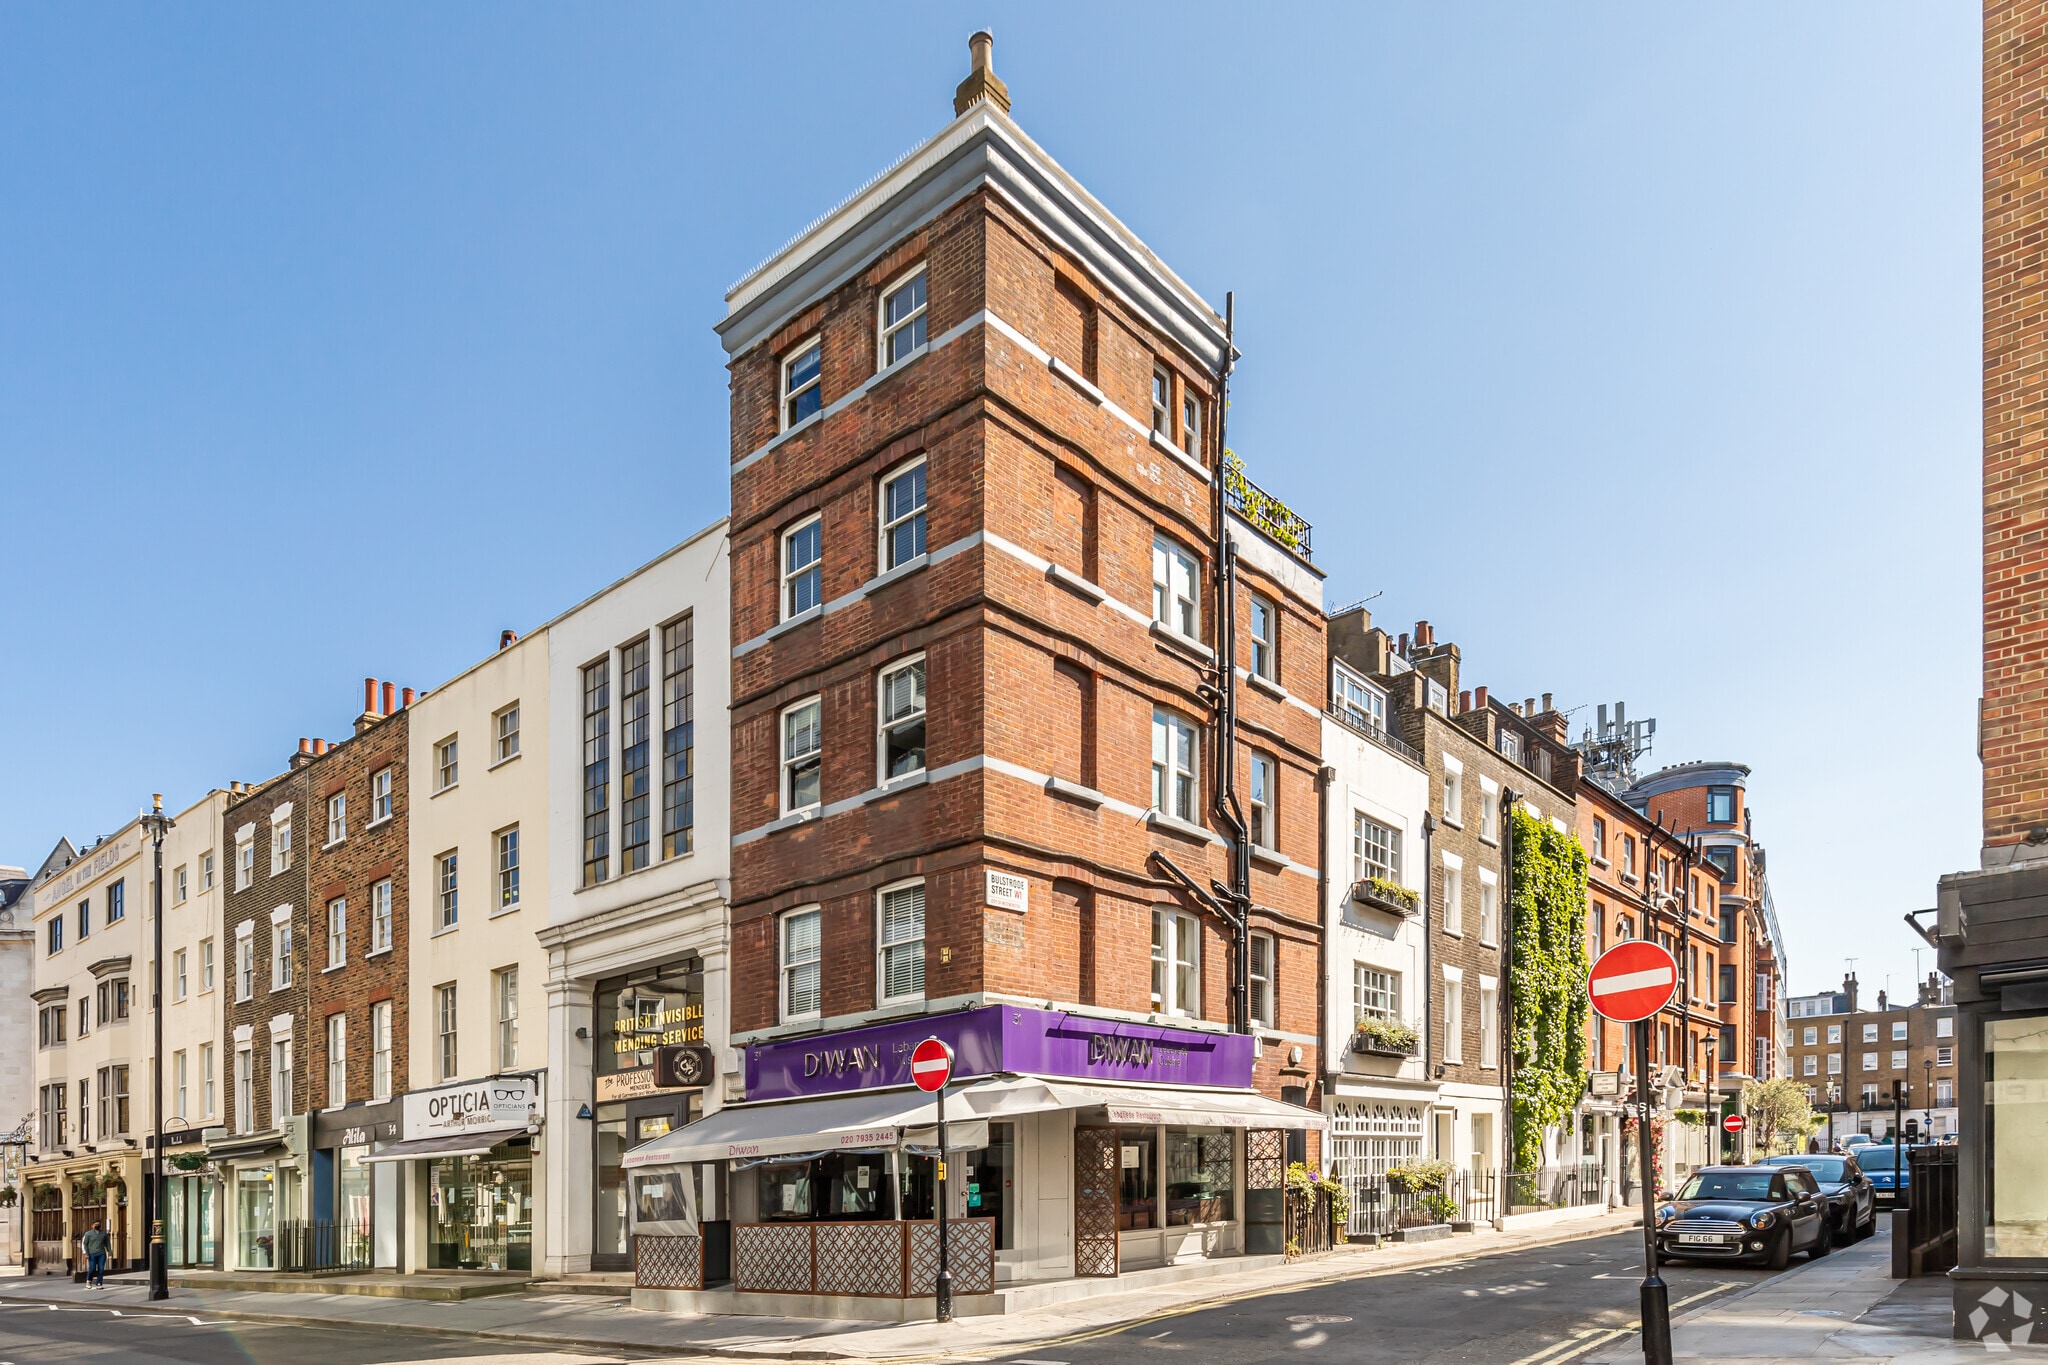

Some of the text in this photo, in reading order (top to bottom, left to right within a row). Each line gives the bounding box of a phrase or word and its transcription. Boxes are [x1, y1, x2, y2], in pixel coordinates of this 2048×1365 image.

[94, 843, 119, 876] FIELDS
[991, 874, 1025, 890] BULSTRODE
[991, 885, 1013, 898] STREET
[614, 1014, 651, 1033] BRITISH
[615, 1025, 704, 1053] MENDING SERVICE
[1091, 1034, 1154, 1065] DIWAN
[804, 1043, 881, 1078] DIWAN
[630, 1083, 651, 1092] MENDERS
[388, 1124, 397, 1136] 34
[443, 1116, 465, 1128] ARTHUR
[728, 1144, 759, 1157] Diwan
[840, 1134, 854, 1145] 020
[856, 1133, 874, 1143] 7935
[875, 1131, 894, 1141] 2445
[1702, 1235, 1714, 1243] 66
